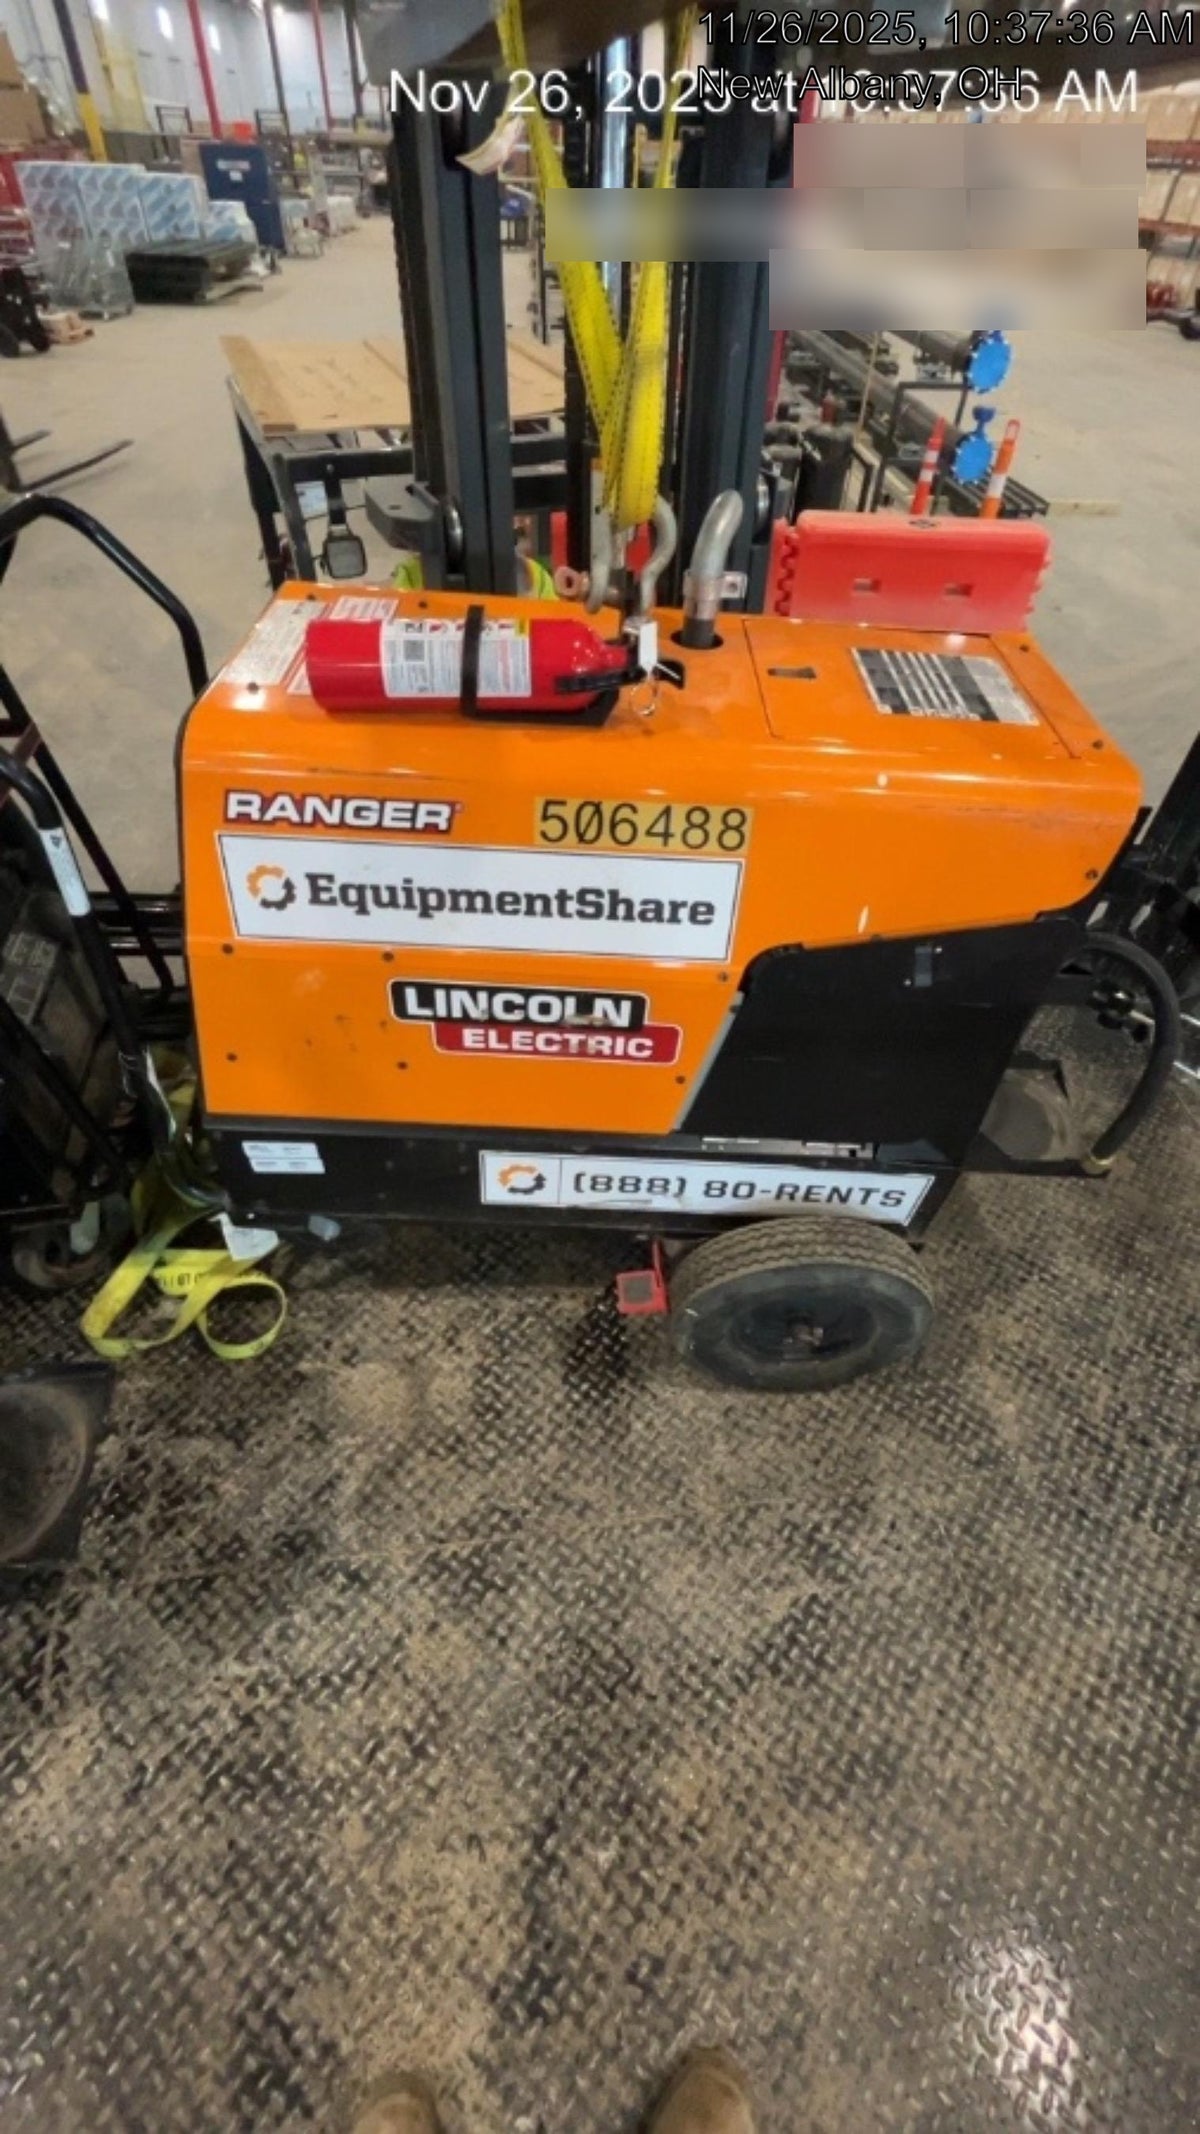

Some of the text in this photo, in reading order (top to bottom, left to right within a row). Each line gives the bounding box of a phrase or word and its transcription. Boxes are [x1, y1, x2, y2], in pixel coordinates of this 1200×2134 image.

[226, 790, 452, 831] RANGER
[539, 799, 748, 852] 506488
[304, 872, 716, 926] EquipmentShare
[404, 986, 633, 1028] LINCOLN
[461, 1027, 654, 1057] ELECTRIC
[573, 1172, 906, 1208] (888) 80-RENTS
